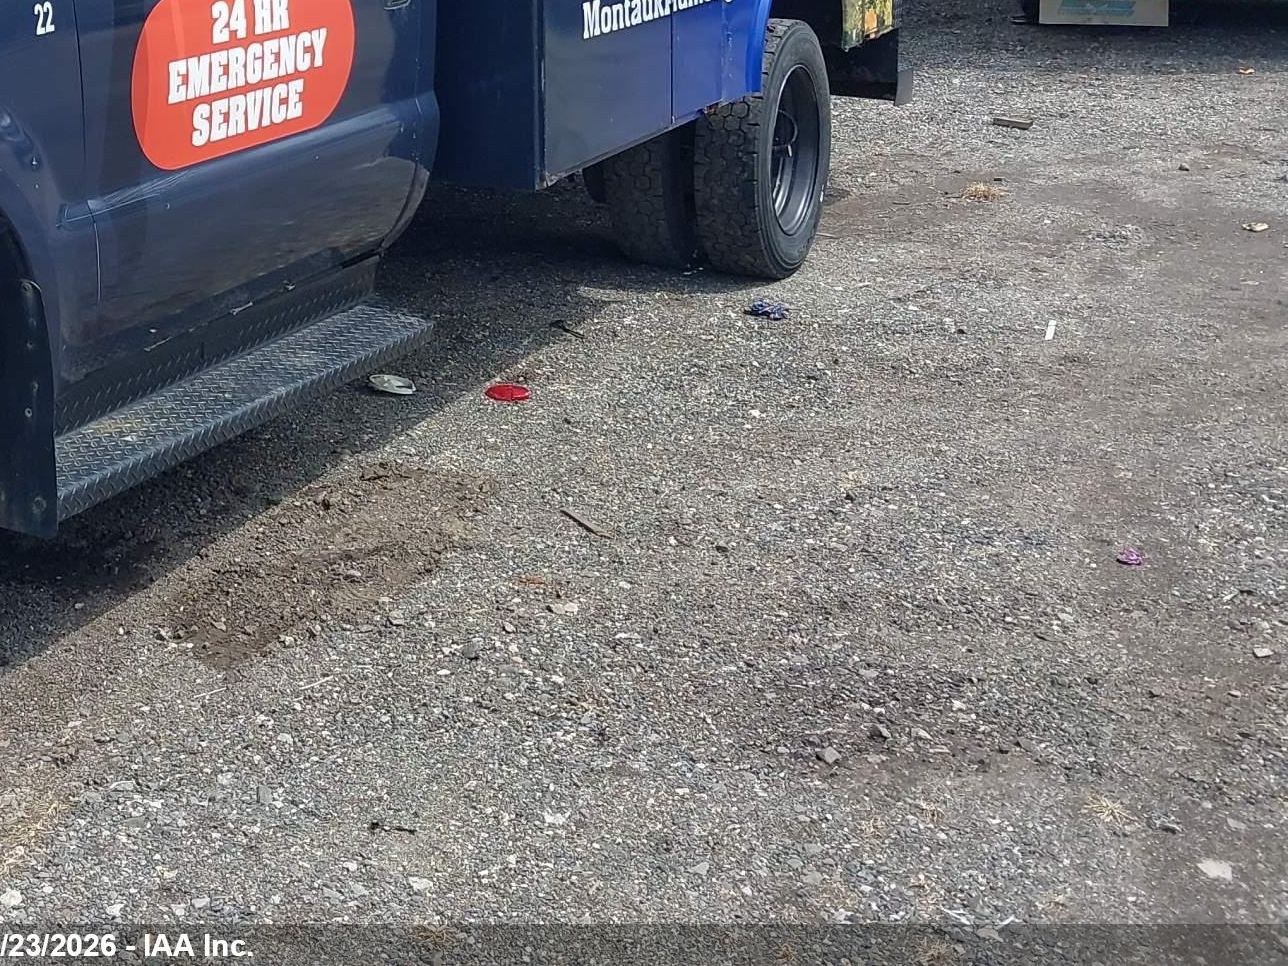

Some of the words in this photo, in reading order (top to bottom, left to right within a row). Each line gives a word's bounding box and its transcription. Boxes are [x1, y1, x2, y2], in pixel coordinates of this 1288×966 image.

[34, 1, 55, 35] 22
[167, 27, 328, 105] EMERGENCY
[191, 78, 305, 148] SERVICE
